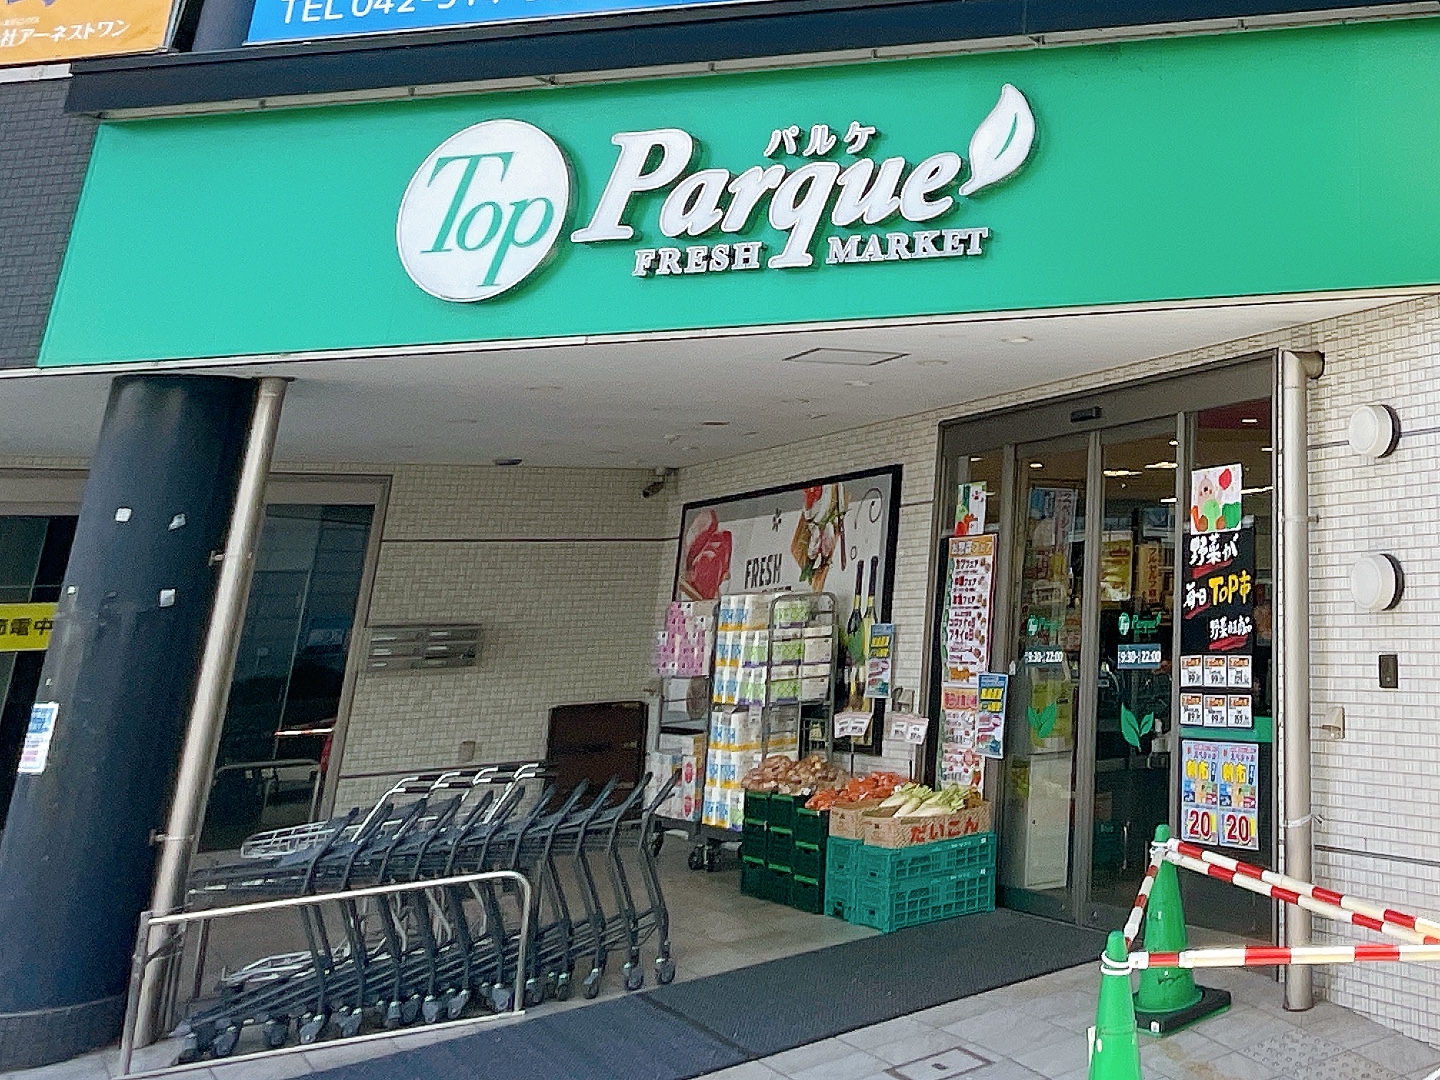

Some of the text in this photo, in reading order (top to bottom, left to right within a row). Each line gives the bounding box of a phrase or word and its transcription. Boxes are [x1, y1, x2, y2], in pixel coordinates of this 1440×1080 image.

[764, 122, 876, 157] パルケ
[571, 128, 962, 269] Parque
[420, 151, 554, 287] Top
[632, 227, 990, 277] FRESH MARKET
[1189, 533, 1239, 566] 野菜が
[745, 553, 782, 590] FRESH
[910, 817, 979, 843] だいこん
[1190, 809, 1210, 837] 20
[1226, 814, 1249, 842] 20
